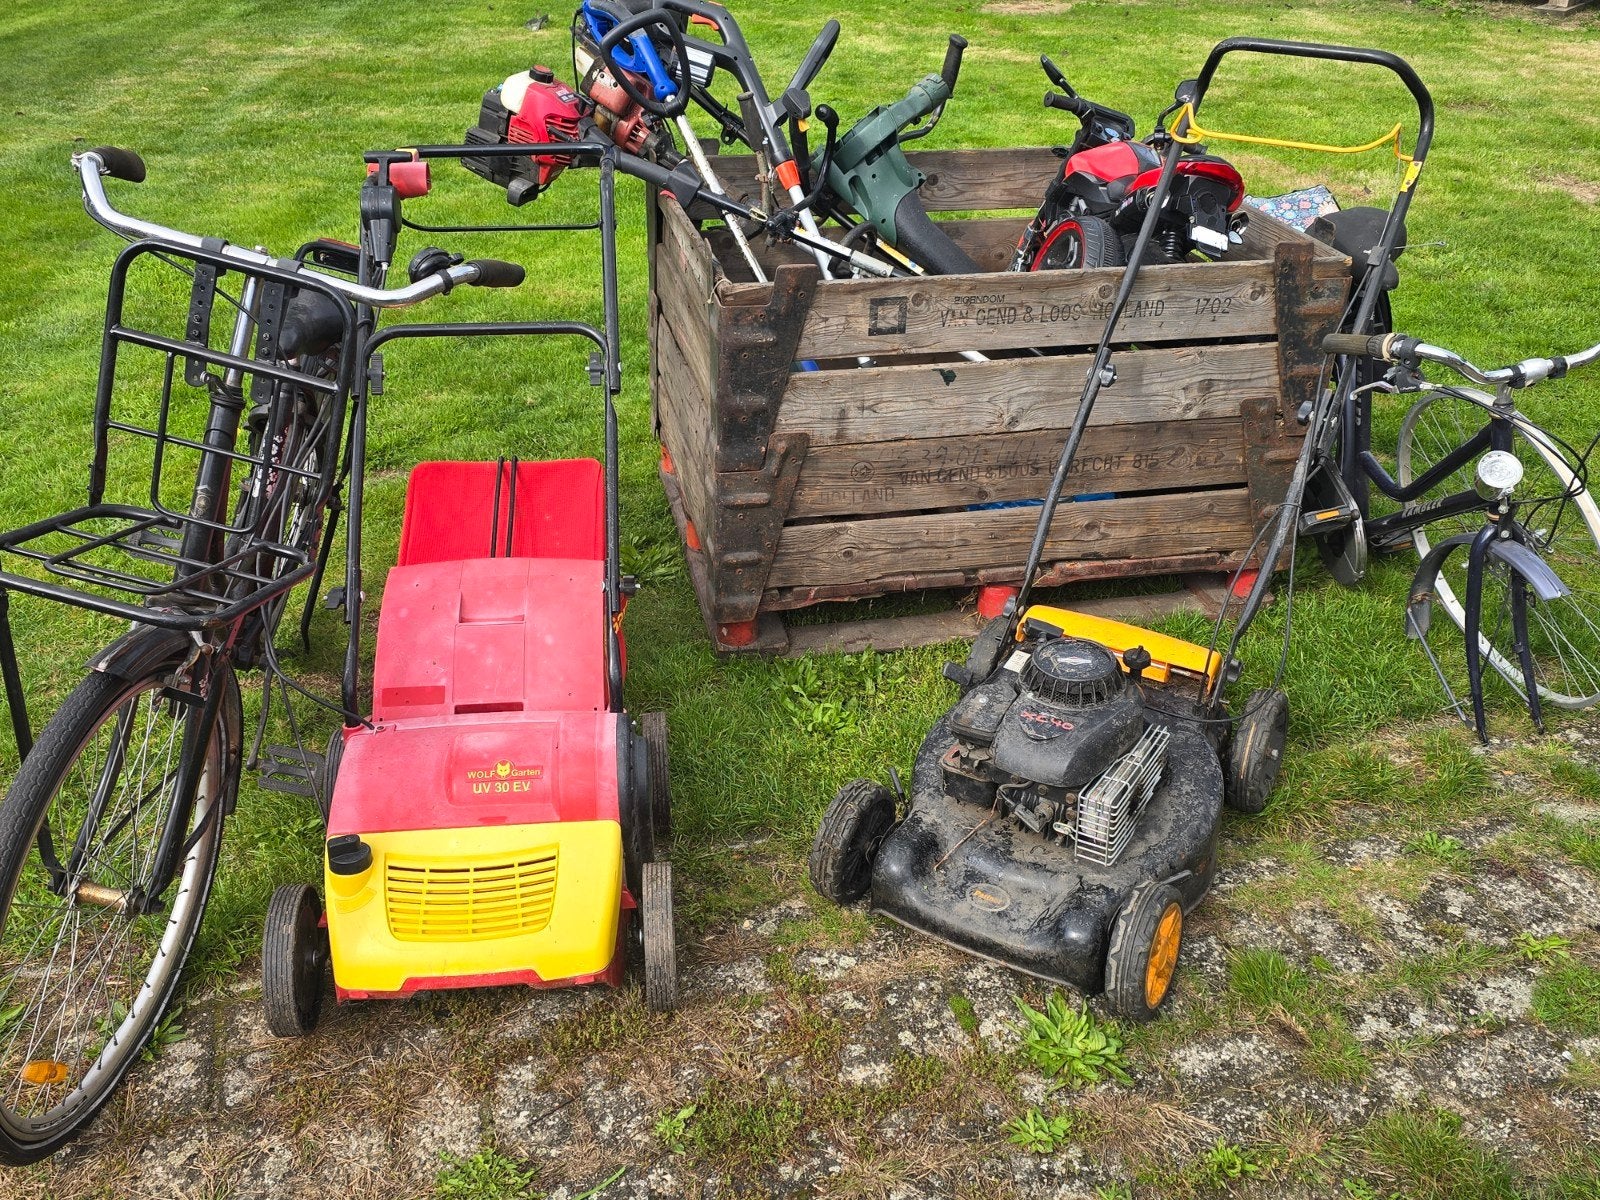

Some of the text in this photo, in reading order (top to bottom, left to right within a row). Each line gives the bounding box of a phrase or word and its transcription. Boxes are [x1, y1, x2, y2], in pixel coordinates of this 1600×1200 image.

[941, 298, 1232, 327] VAN GEND & LOOS HOLAND 1702
[1048, 455, 1123, 475] URECHT
[467, 768, 541, 779] WOLF Garten
[472, 780, 531, 794] UV 30 EV
